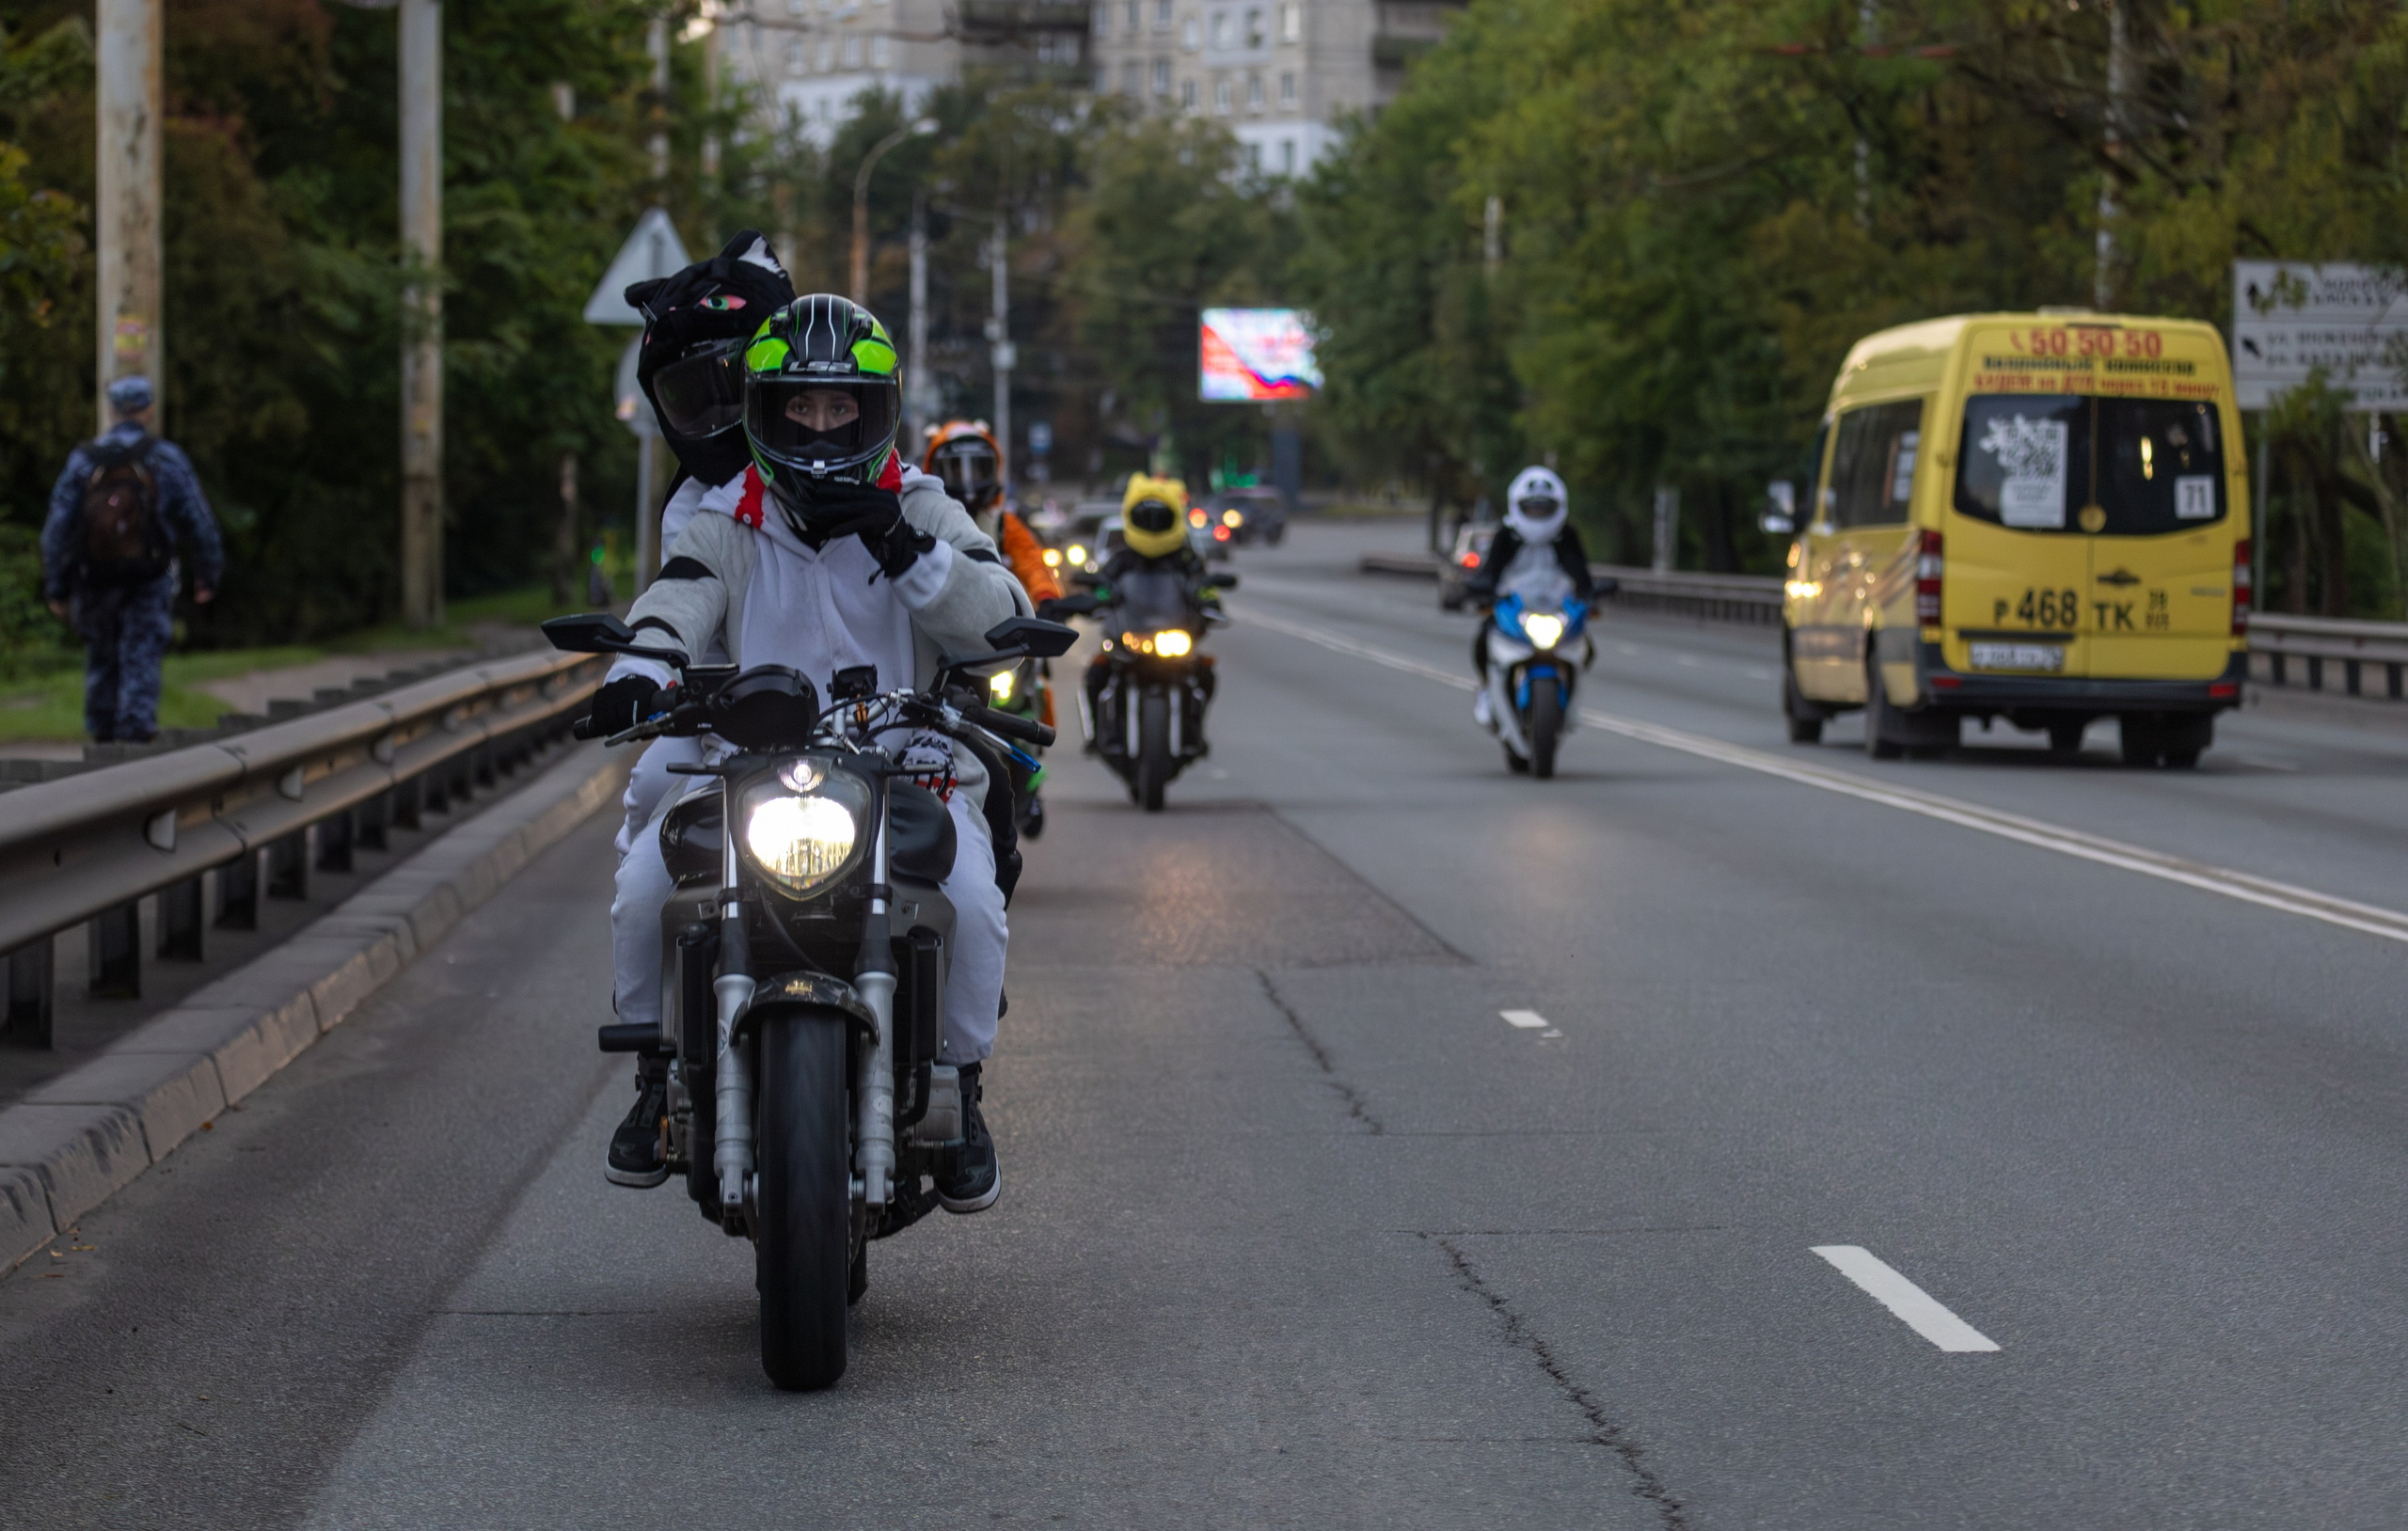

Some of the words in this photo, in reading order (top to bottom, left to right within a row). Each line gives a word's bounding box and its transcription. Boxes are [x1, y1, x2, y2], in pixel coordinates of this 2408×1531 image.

[2029, 329, 2067, 356] 50
[2077, 329, 2115, 357] 50
[2124, 330, 2162, 358] 50
[2018, 586, 2079, 629] 468
[2092, 601, 2134, 631] ТК
